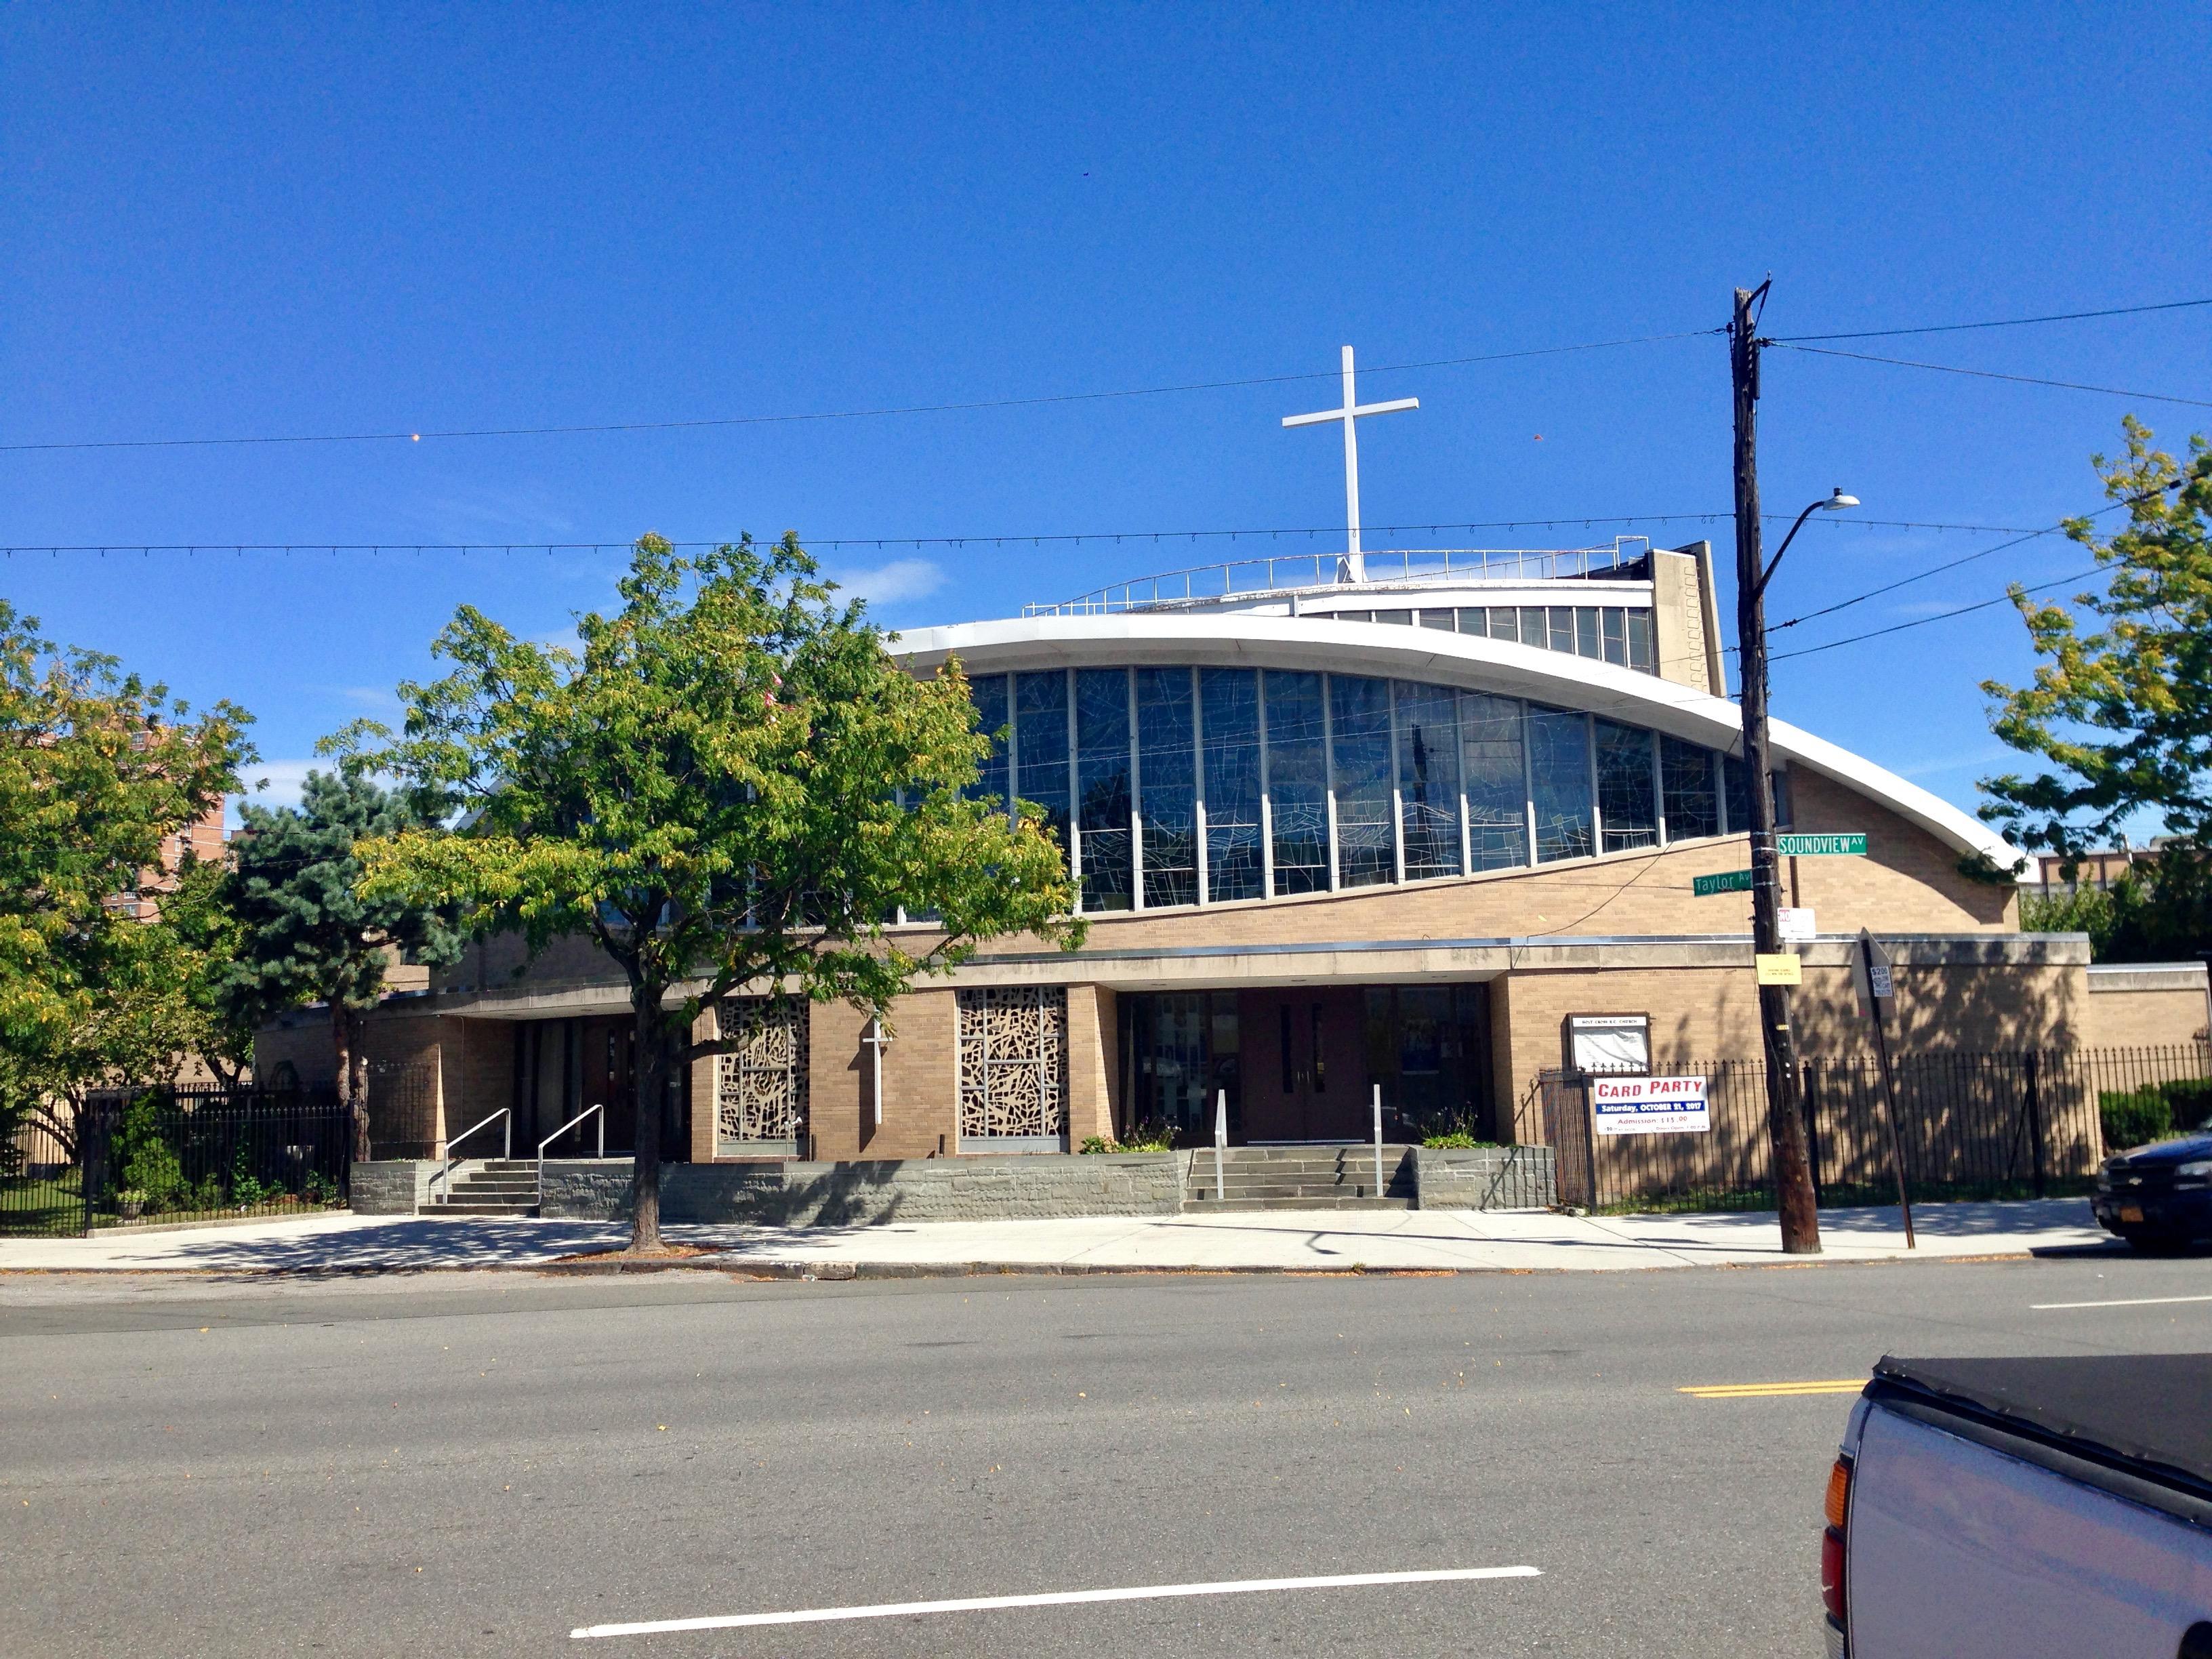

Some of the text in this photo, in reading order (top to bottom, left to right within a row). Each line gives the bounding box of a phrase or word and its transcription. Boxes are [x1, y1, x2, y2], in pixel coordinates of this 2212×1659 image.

[1780, 836, 1864, 854] SOUNDVIEW AV
[1696, 875, 1734, 893] Taylor
[1598, 1081, 1702, 1097] CARD PARTY
[1601, 1105, 1639, 1113] Saturday,
[1640, 1103, 1672, 1111] OCTOBER
[1685, 1102, 1702, 1110] 2017
